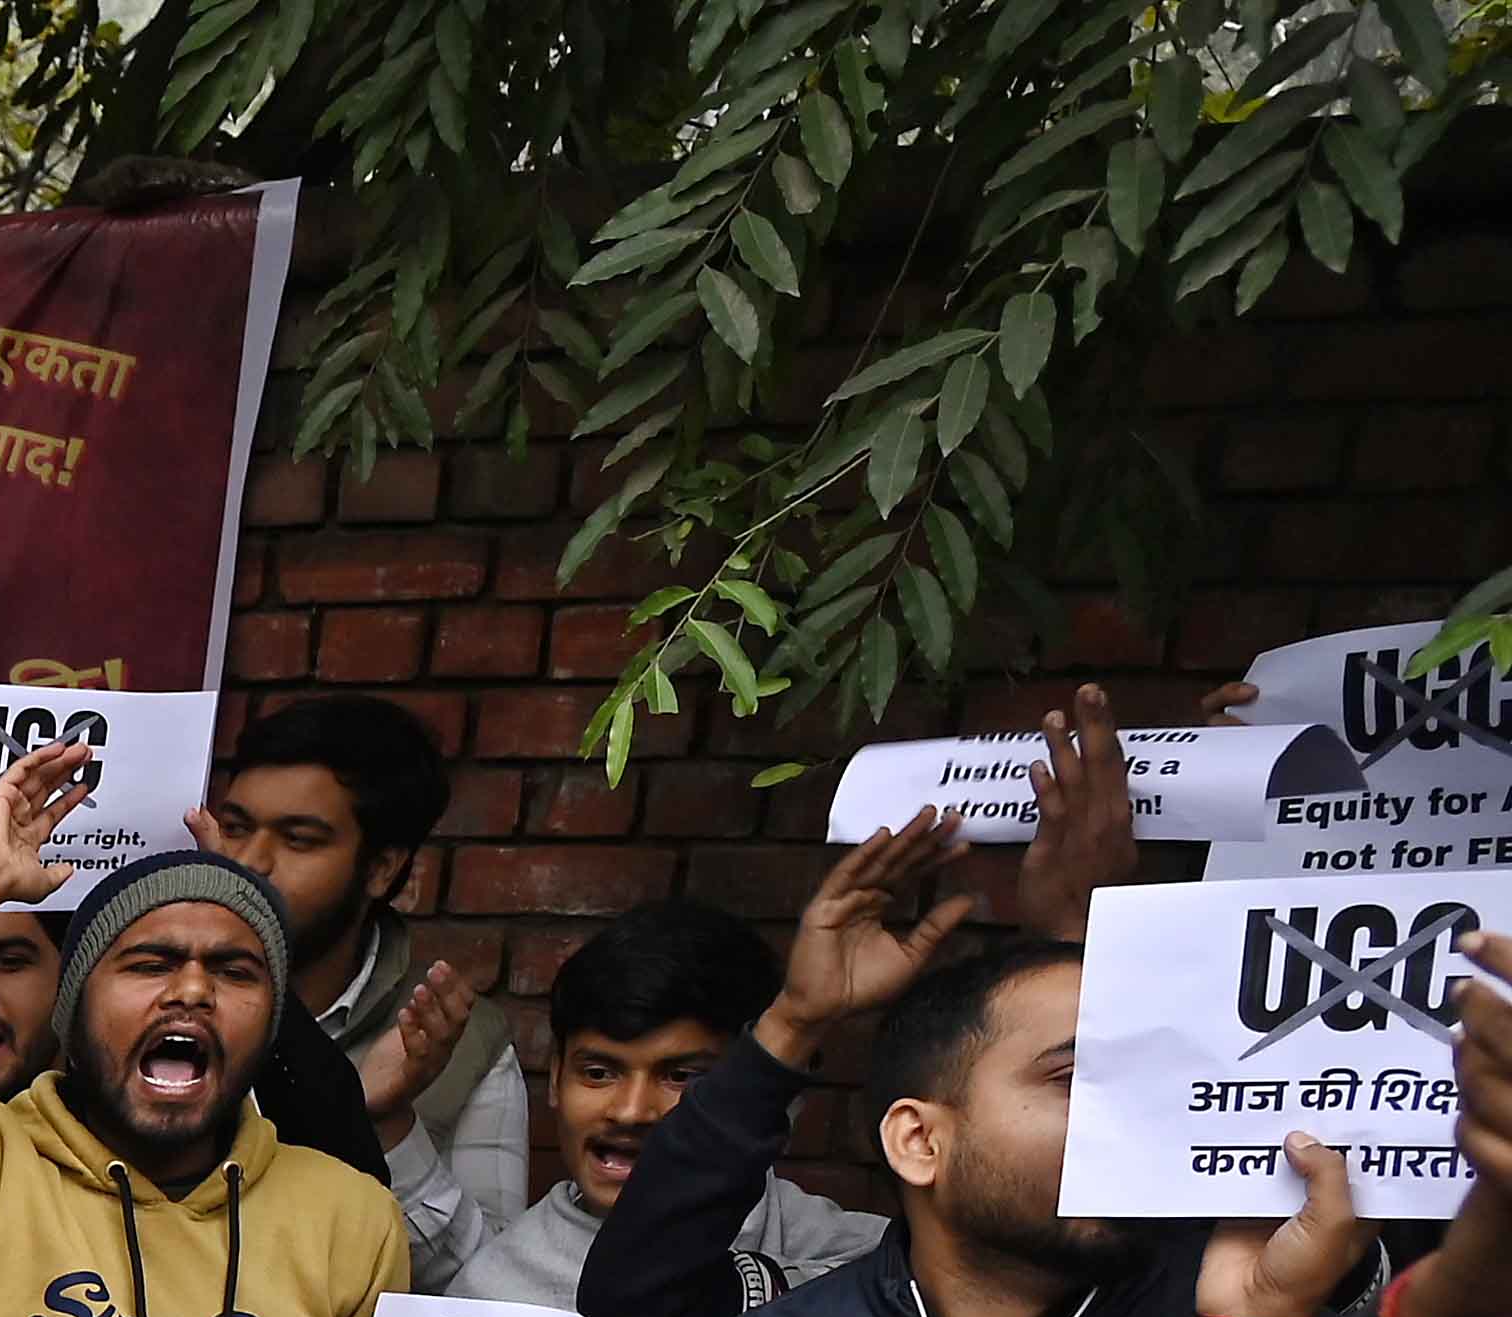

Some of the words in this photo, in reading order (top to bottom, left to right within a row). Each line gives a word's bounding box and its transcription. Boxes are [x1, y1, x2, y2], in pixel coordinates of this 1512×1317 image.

[1277, 791, 1414, 829] Equity
[1428, 787, 1487, 816] for
[1302, 844, 1376, 870] not
[1392, 840, 1453, 869] for
[1238, 902, 1480, 1033] UGC
[1189, 1079, 1289, 1112] आज
[1299, 1068, 1362, 1112] की
[1370, 1068, 1461, 1115] शिक्ष
